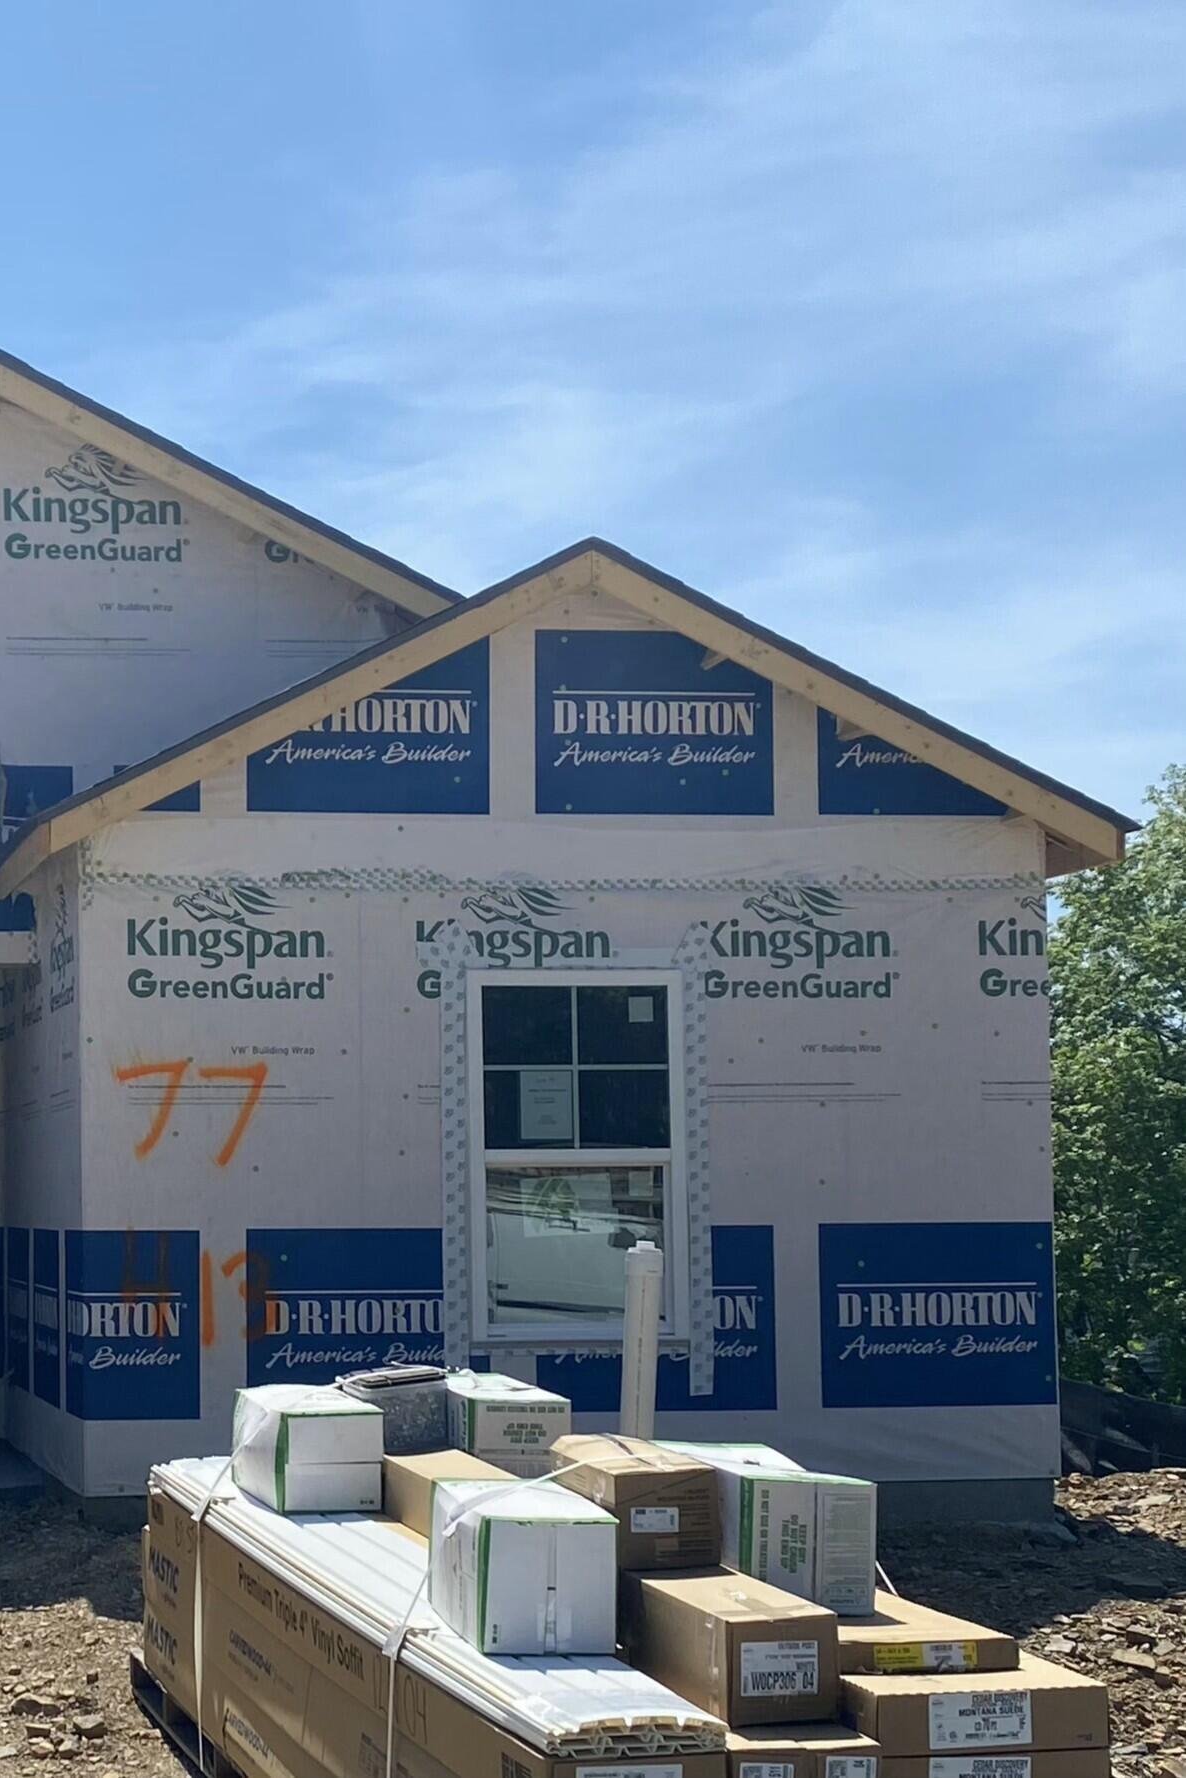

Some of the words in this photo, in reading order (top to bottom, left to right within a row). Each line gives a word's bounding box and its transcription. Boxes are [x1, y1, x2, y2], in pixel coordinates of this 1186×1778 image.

[3, 486, 182, 535] Kingspan
[4, 532, 183, 563] GreenGuard
[265, 738, 377, 765] America's
[381, 741, 471, 765] Builder
[553, 742, 663, 769] America's
[667, 742, 756, 768] Builder
[126, 917, 326, 969] Kingspan
[127, 968, 326, 999] GreenGuard
[704, 969, 892, 999] GreenGuard
[252, 1046, 289, 1057] Building
[291, 1046, 316, 1056] Wrap
[117, 1061, 268, 1168] 77
[88, 1346, 181, 1370] Builder
[265, 1342, 377, 1369] America's
[839, 1335, 948, 1360] America's
[951, 1335, 1038, 1357] Builder
[149, 1545, 179, 1594] MASTIC
[238, 1561, 273, 1608] Premium
[274, 1589, 299, 1633] Triple
[311, 1614, 335, 1665] Vinyl
[336, 1632, 365, 1681] Soffit
[147, 1614, 178, 1667] MASTIC
